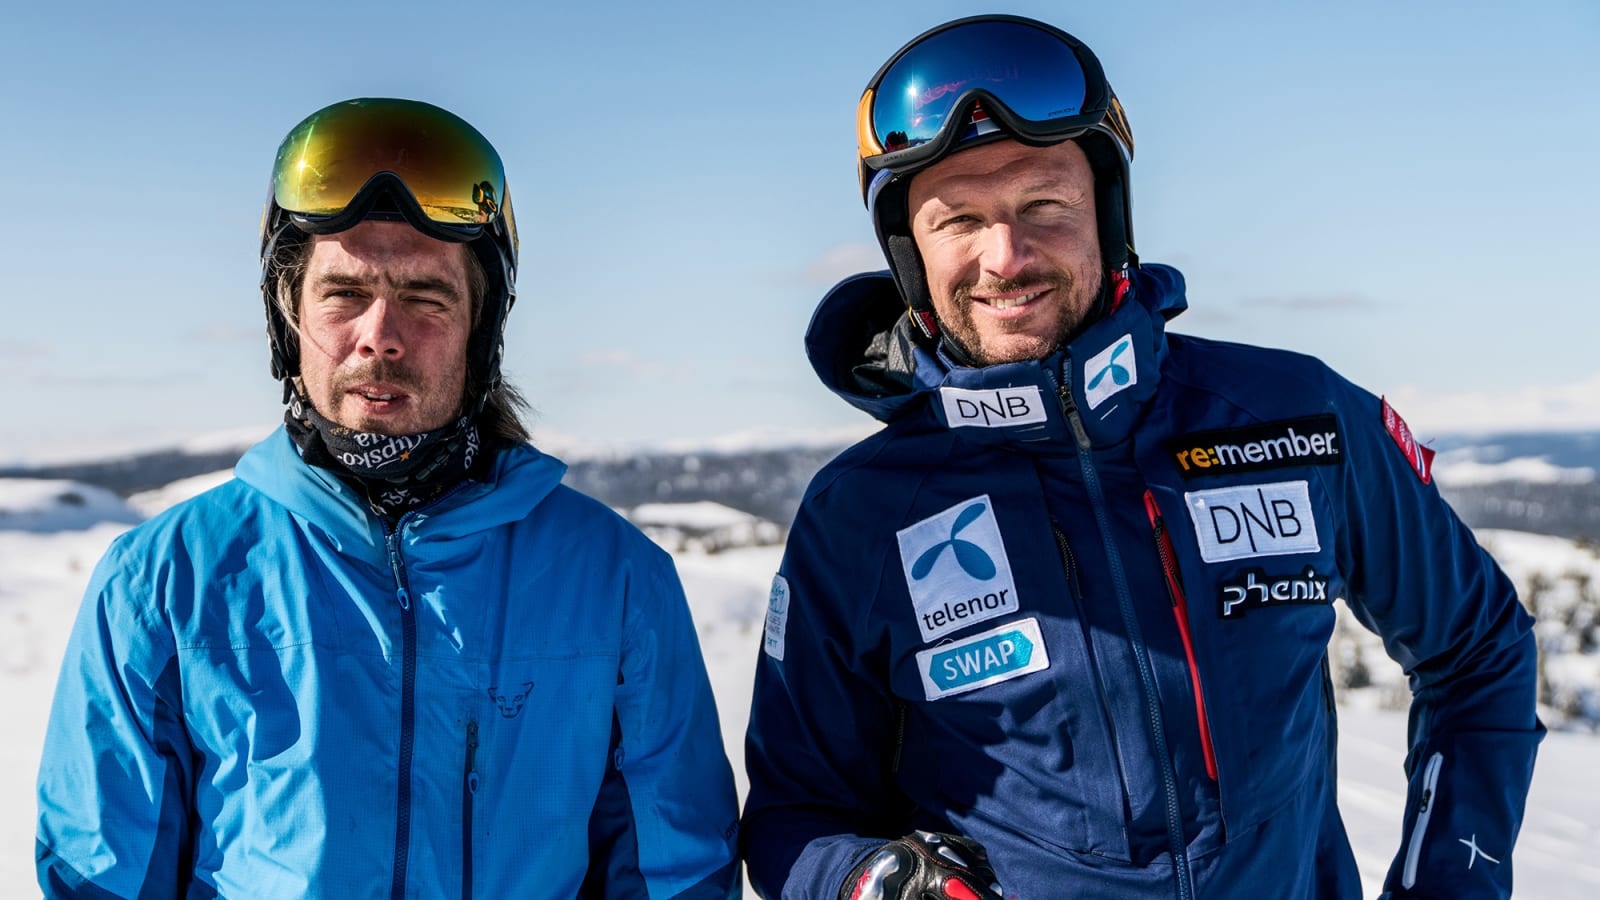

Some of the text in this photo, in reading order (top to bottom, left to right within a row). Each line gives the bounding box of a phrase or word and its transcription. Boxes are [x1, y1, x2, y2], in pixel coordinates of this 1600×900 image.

[956, 391, 1030, 426] DNB
[1176, 427, 1337, 471] re:member
[1209, 488, 1302, 553] DNB
[923, 588, 1009, 631] telenor
[1223, 569, 1326, 616] phenix
[943, 639, 1015, 681] SWAP
